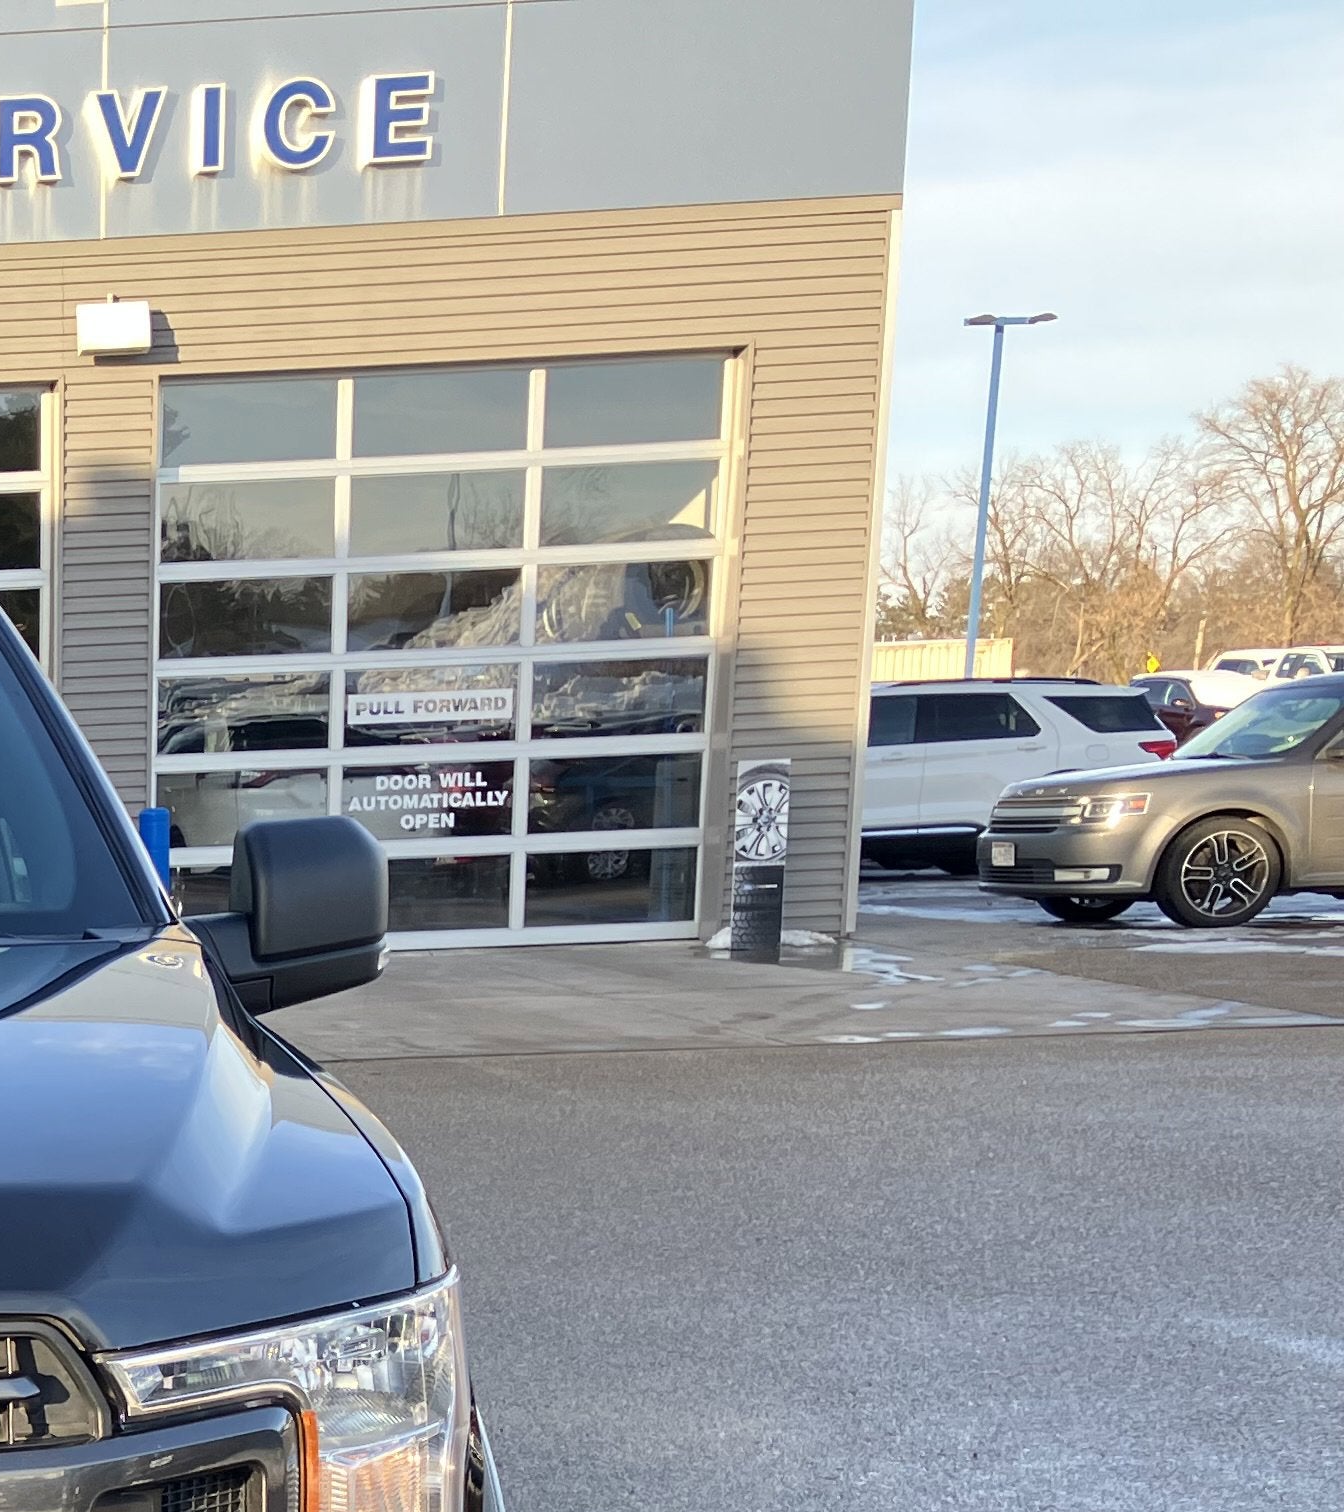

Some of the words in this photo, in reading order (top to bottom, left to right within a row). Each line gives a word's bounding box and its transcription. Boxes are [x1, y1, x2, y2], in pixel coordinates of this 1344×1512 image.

[355, 699, 405, 716] PULL
[412, 696, 508, 714] FORWARD
[375, 773, 432, 791] DOOR
[439, 771, 488, 789] WILL
[348, 790, 509, 812] AUTOMATICALLY
[399, 812, 455, 830] OPEN
